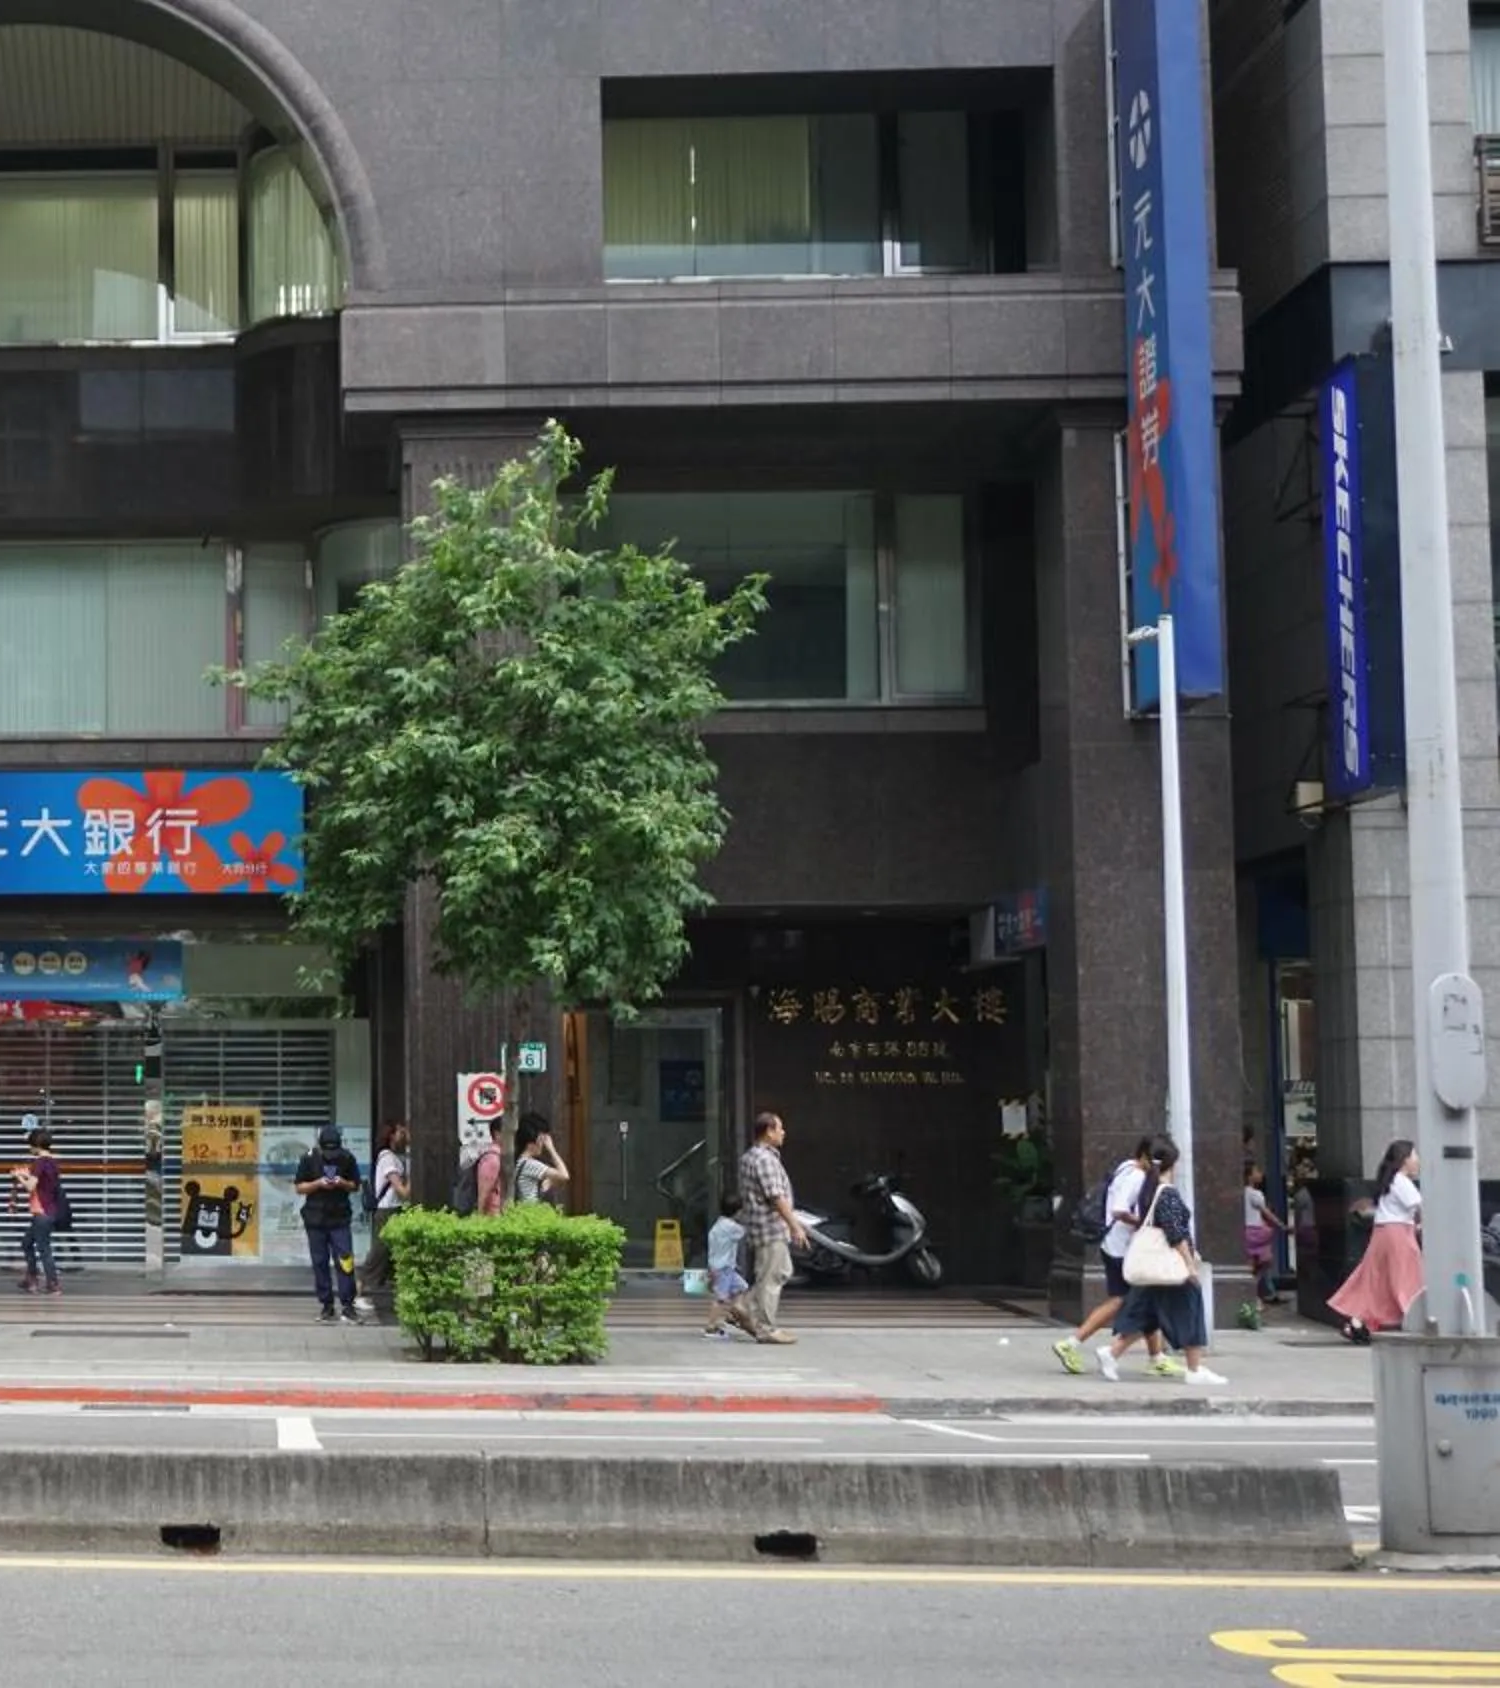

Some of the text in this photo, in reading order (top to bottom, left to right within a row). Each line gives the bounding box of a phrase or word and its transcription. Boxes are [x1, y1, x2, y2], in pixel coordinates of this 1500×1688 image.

[1133, 190, 1159, 472] 元大銀行
[1331, 385, 1359, 778] SKECHERS
